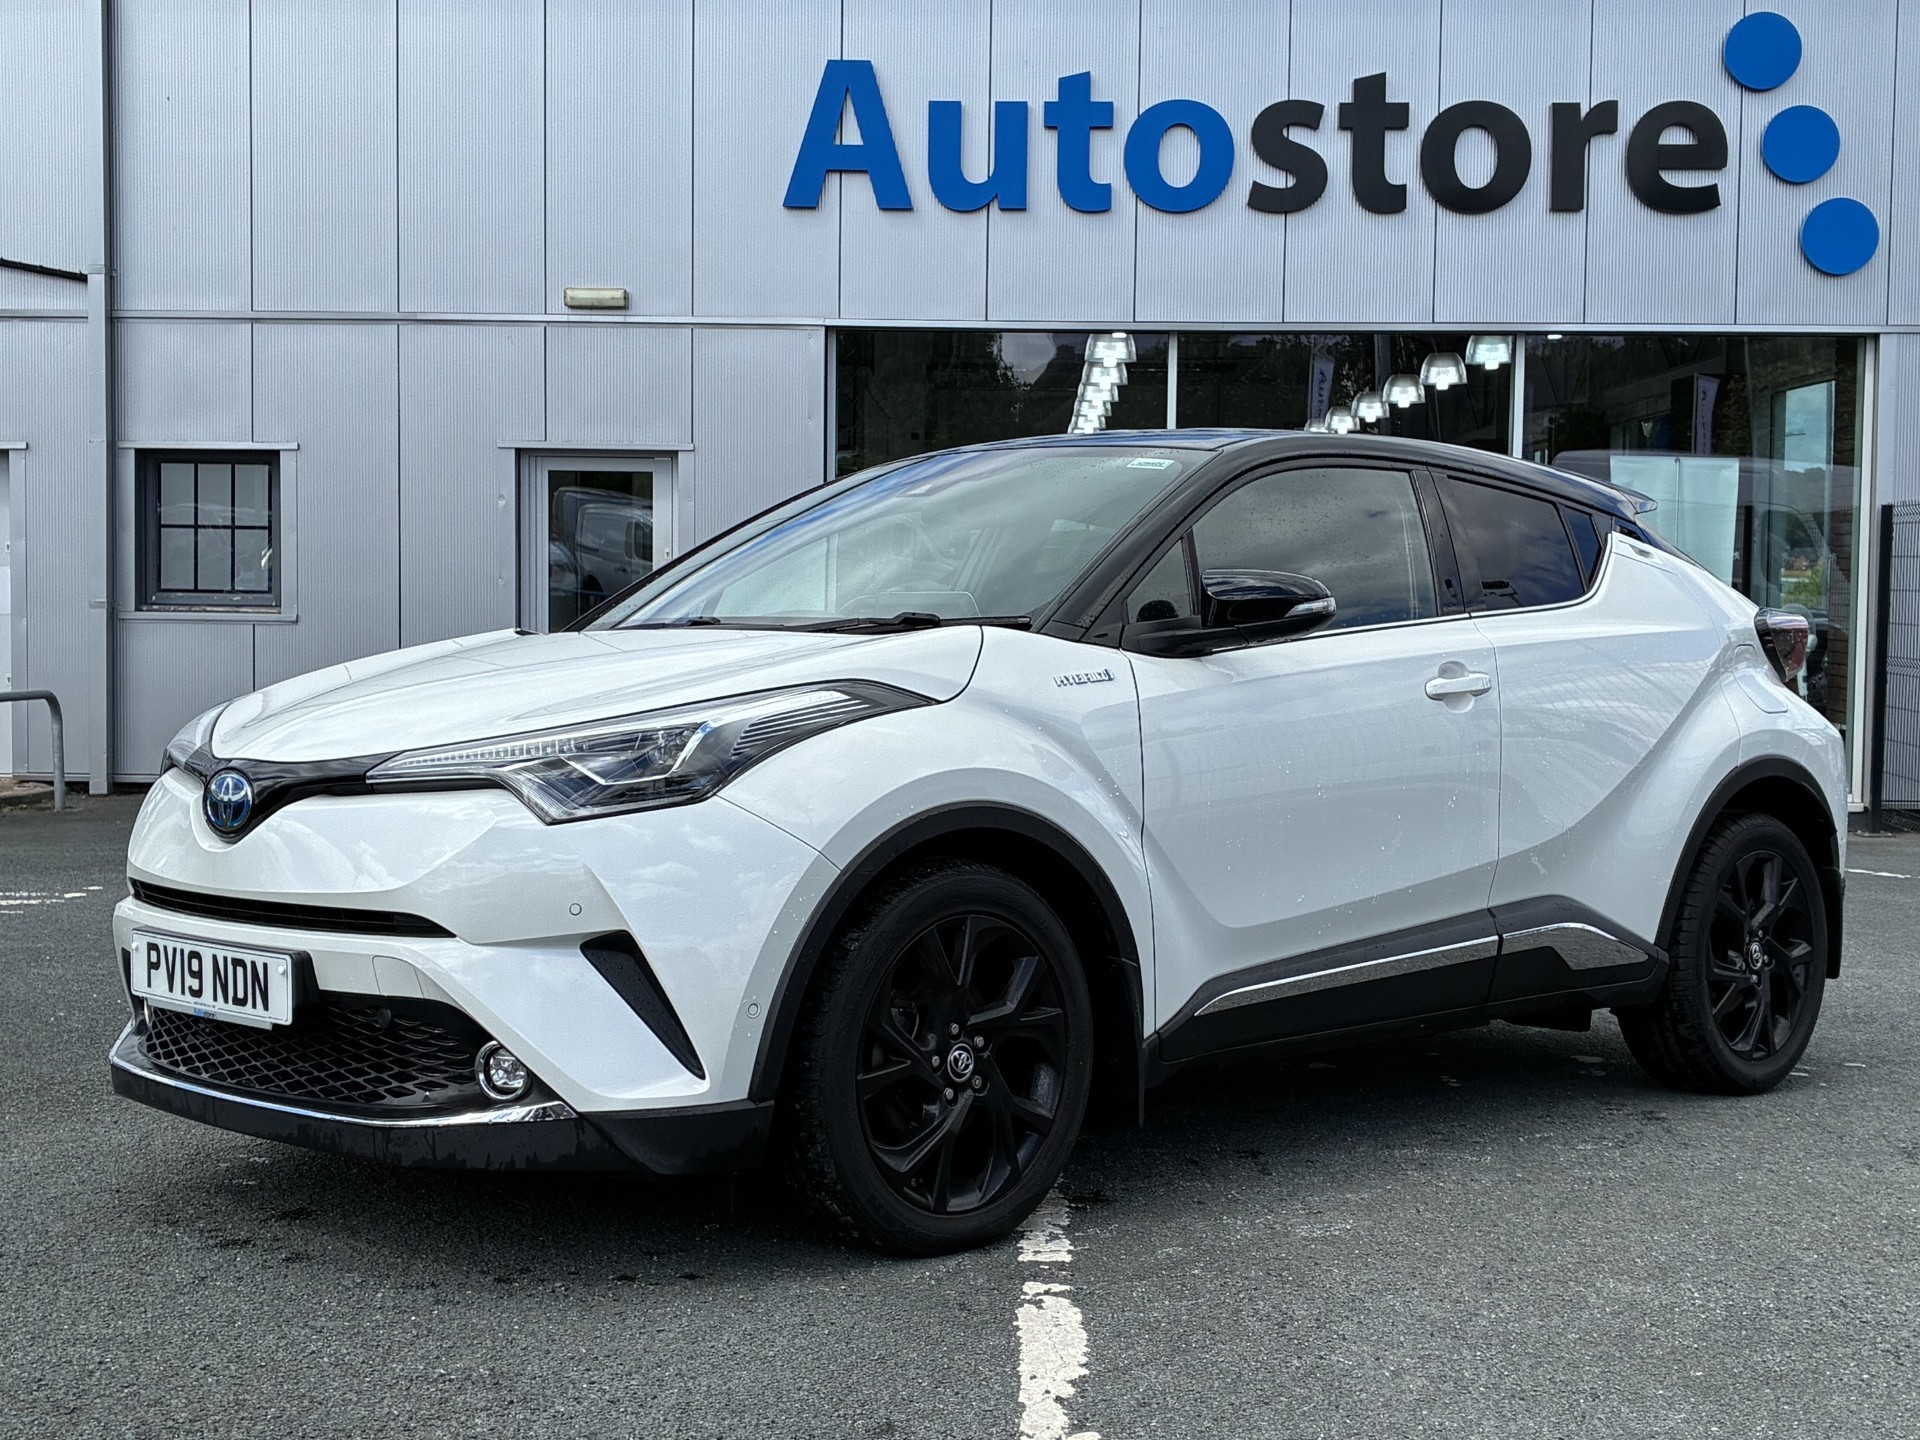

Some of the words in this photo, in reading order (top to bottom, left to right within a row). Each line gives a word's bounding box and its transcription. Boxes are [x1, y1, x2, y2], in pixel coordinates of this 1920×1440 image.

[784, 60, 1729, 215] Autostore
[1053, 668, 1115, 687] HYBRID
[147, 942, 203, 998] PV19
[213, 954, 269, 1011] NDN
